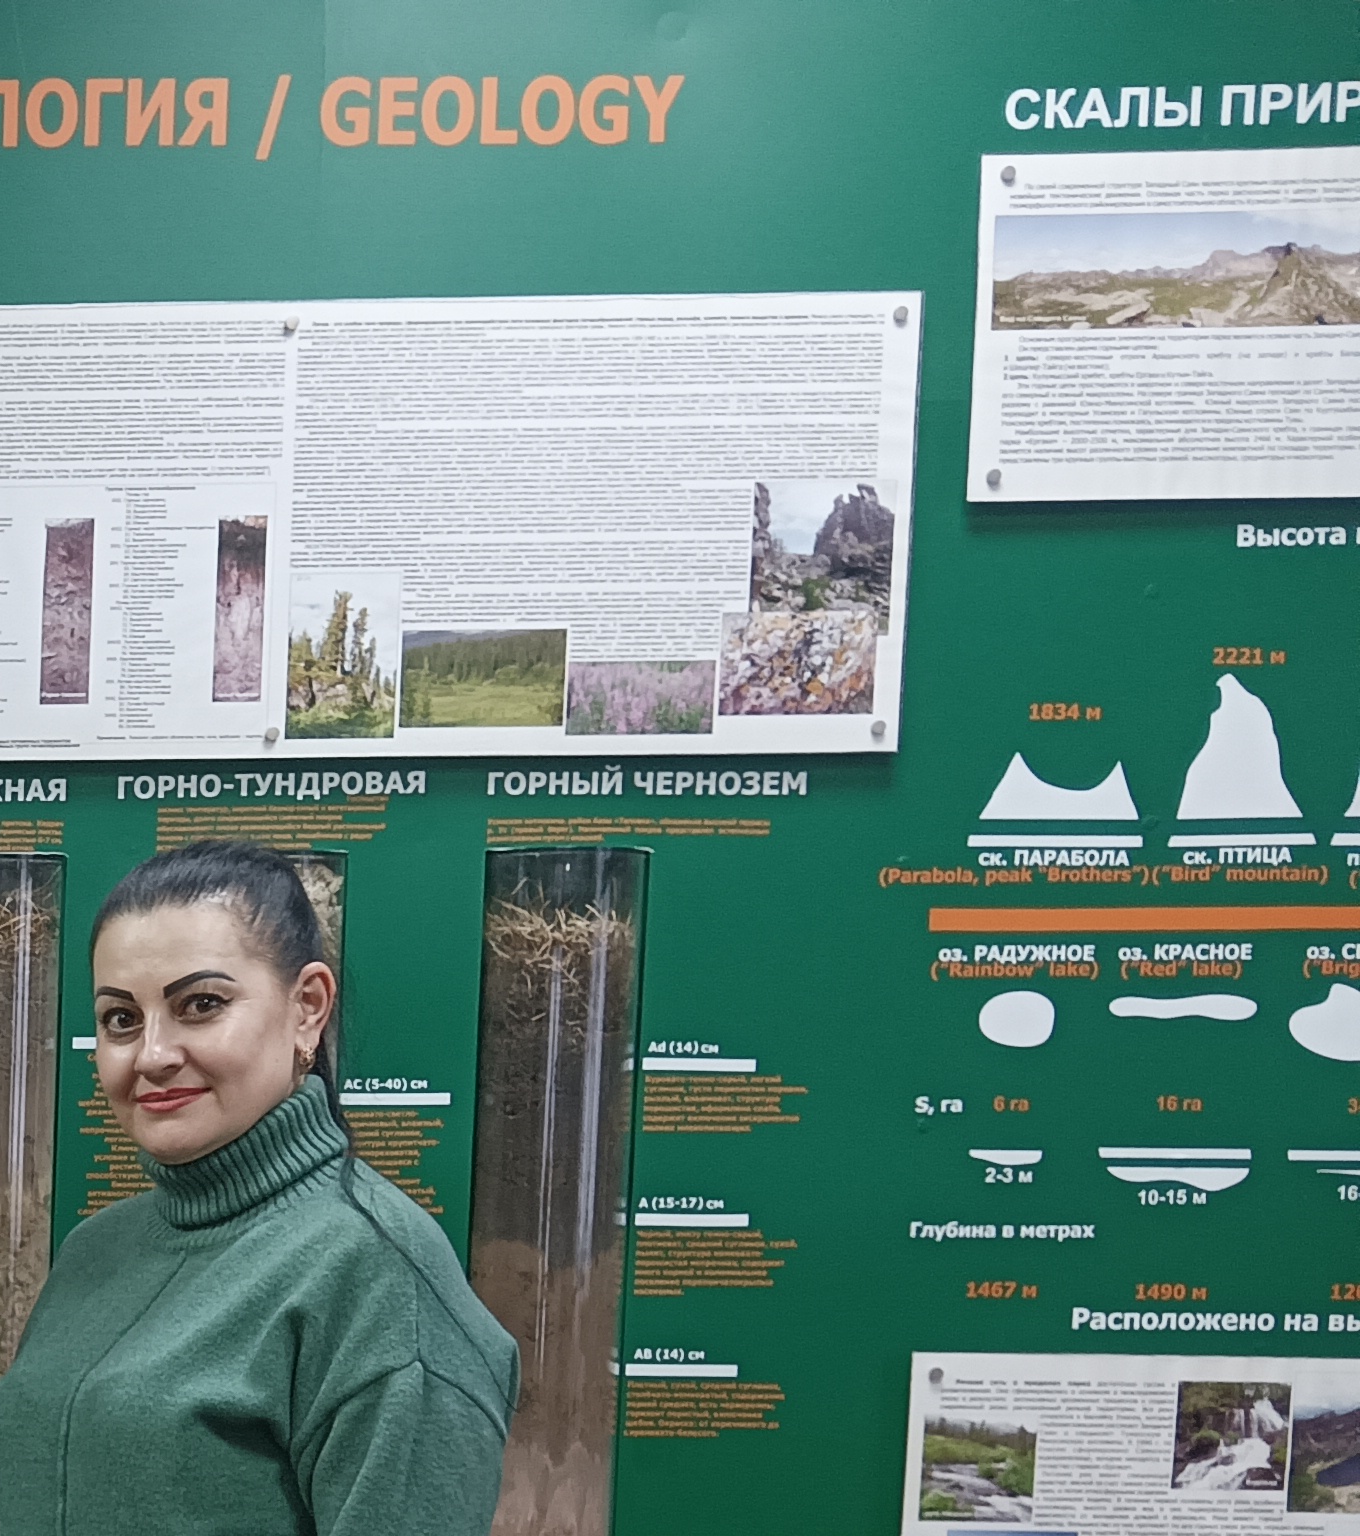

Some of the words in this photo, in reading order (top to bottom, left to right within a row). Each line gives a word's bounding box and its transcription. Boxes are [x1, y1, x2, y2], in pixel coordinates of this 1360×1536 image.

[255, 73, 292, 161] /
[319, 74, 686, 147] GEOLOGY
[1004, 85, 1203, 130] СКАЛЫ
[1236, 523, 1347, 548] Высота
[1212, 647, 1264, 665] 2221
[1269, 651, 1286, 664] м
[1029, 703, 1081, 721] 1834
[1085, 707, 1102, 720] м
[115, 769, 428, 801] ГОРНО-ТУНДРОВАЯ
[486, 764, 624, 796] ГОРНЫЙ
[633, 770, 808, 796] ЧЕРНОЗЕМ
[977, 852, 1008, 867] ск.
[1013, 849, 1130, 867] ПАРАБОЛА
[1182, 851, 1213, 865] ск.
[1218, 846, 1293, 867] ПТИЦА
[878, 866, 980, 888] (Parabola,
[984, 867, 1033, 887] peak
[1225, 865, 1329, 886] mountain)
[937, 948, 968, 964] оз.
[974, 944, 1097, 964] РАДУЖНОЕ
[1117, 947, 1149, 962] оз.
[1153, 943, 1253, 962] КРАСНОЕ
[1305, 946, 1336, 962] оз.
[1048, 961, 1100, 981] lake)
[1192, 961, 1243, 981] lake)
[668, 1040, 699, 1056] (14)
[914, 1095, 935, 1116] S,
[940, 1098, 963, 1113] га
[993, 1095, 1006, 1112] 6
[1009, 1098, 1030, 1112] га
[1157, 1095, 1179, 1112] 16
[1182, 1098, 1203, 1112] га
[984, 1167, 1014, 1184] 2-3
[1018, 1170, 1033, 1183] м
[1137, 1188, 1188, 1206] 10-15
[1192, 1192, 1208, 1205] м
[909, 1220, 997, 1242] Глубина
[1001, 1224, 1015, 1239] в
[1019, 1224, 1095, 1243] метрах
[966, 1281, 1017, 1299] 1467
[1021, 1285, 1038, 1299] м
[1135, 1283, 1187, 1301] 1490
[1191, 1287, 1208, 1301] м
[1071, 1306, 1276, 1332] Расположено
[1283, 1313, 1319, 1332] на
